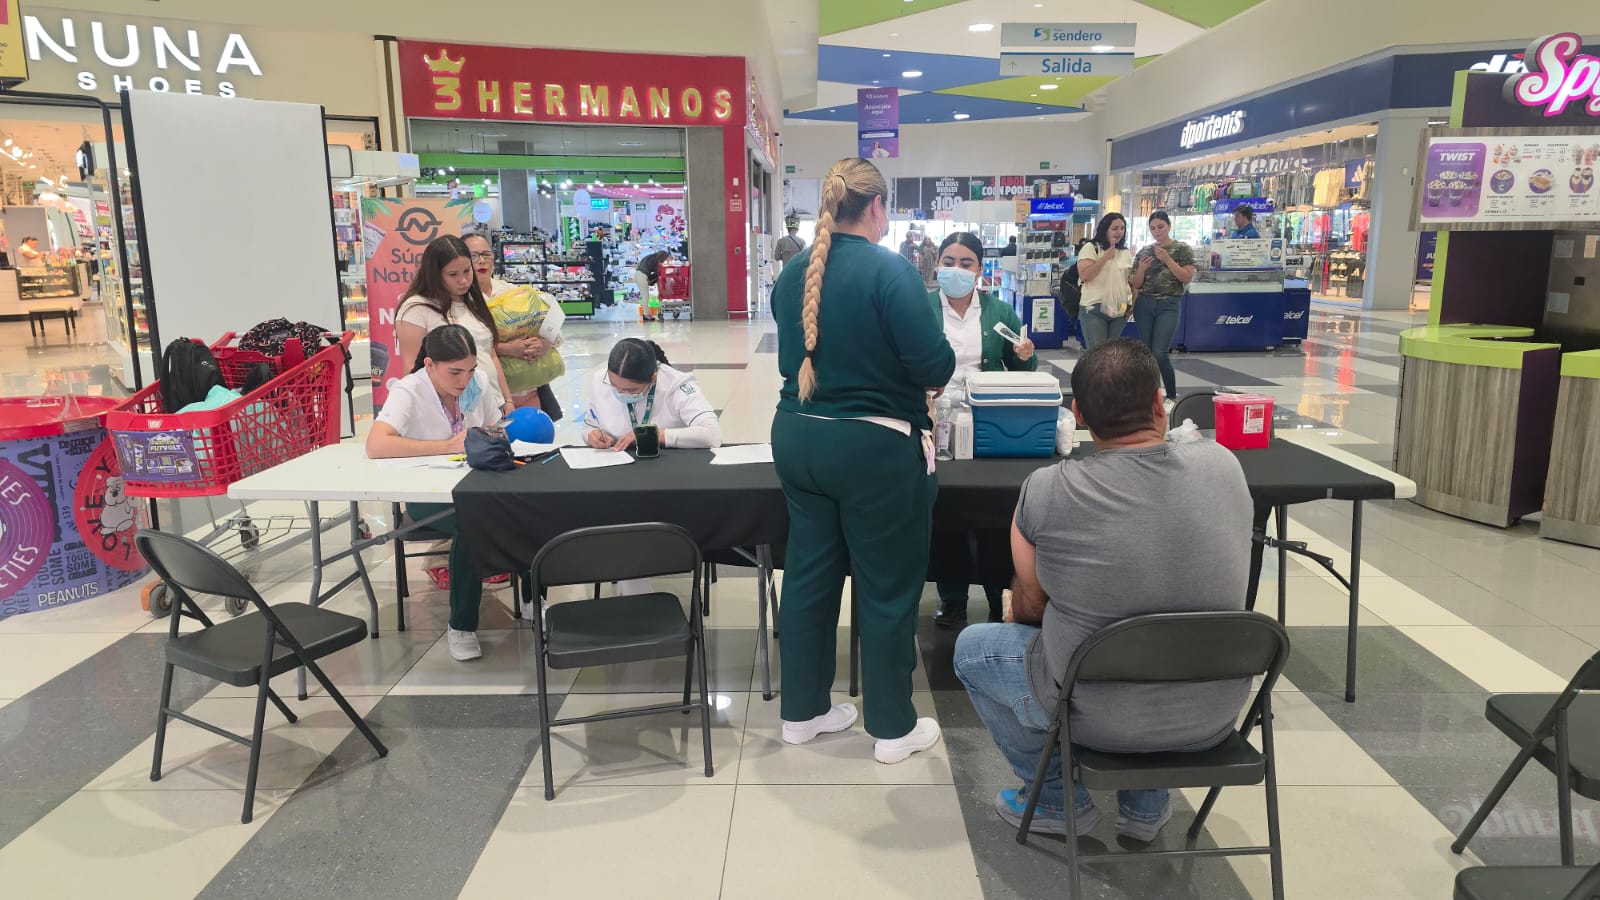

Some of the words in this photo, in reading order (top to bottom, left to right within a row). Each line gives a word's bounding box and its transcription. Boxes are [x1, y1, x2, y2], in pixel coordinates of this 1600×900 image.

[24, 15, 263, 76] NUNA
[1053, 29, 1102, 41] sendero
[1042, 58, 1092, 73] Salida
[78, 71, 236, 98] SHOES
[432, 76, 461, 110] 3
[477, 80, 732, 120] HERMANOS
[1180, 110, 1246, 149] dportenis
[1439, 152, 1476, 162] TWIST
[1225, 314, 1254, 325] telcel
[48, 547, 65, 586] SOME
[66, 557, 97, 573] SOME
[37, 582, 99, 607] PEANUTS
